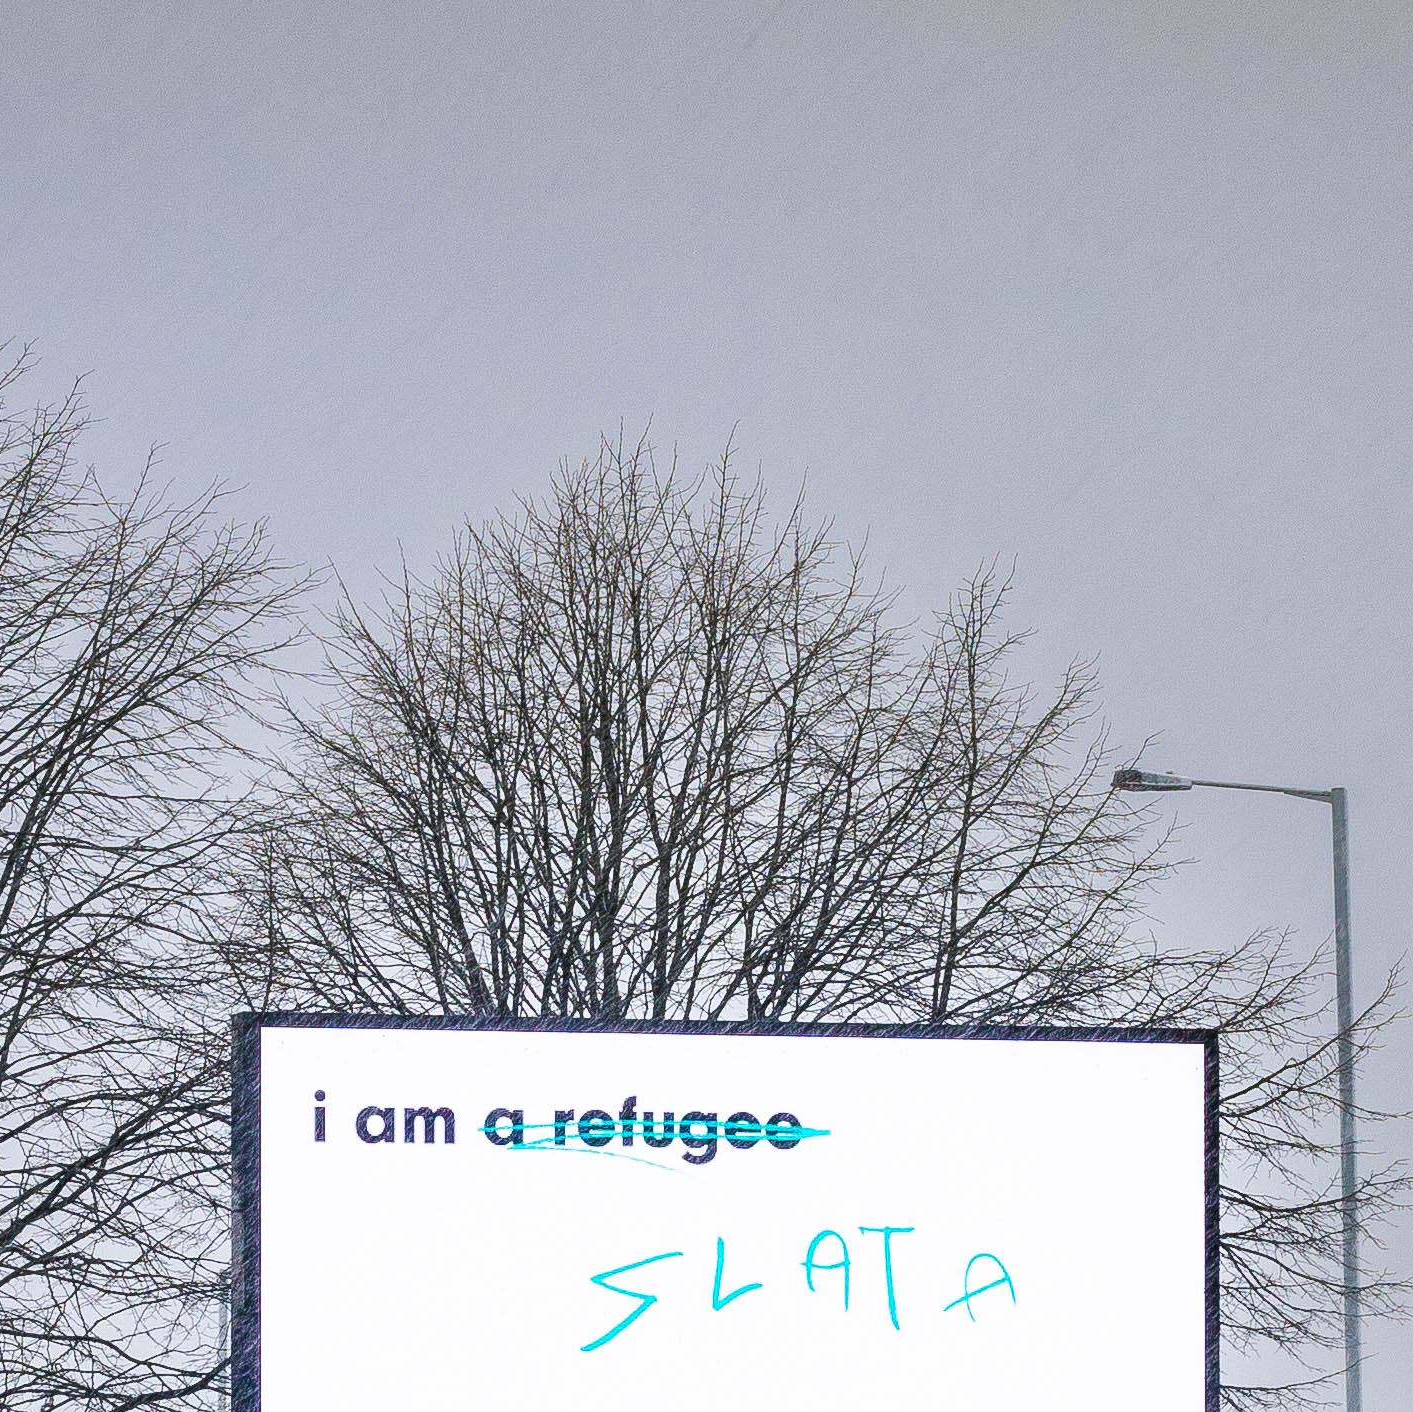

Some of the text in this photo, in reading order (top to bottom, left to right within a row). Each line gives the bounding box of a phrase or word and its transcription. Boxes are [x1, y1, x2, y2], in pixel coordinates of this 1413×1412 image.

[314, 1089, 803, 1165] i am a refugee
